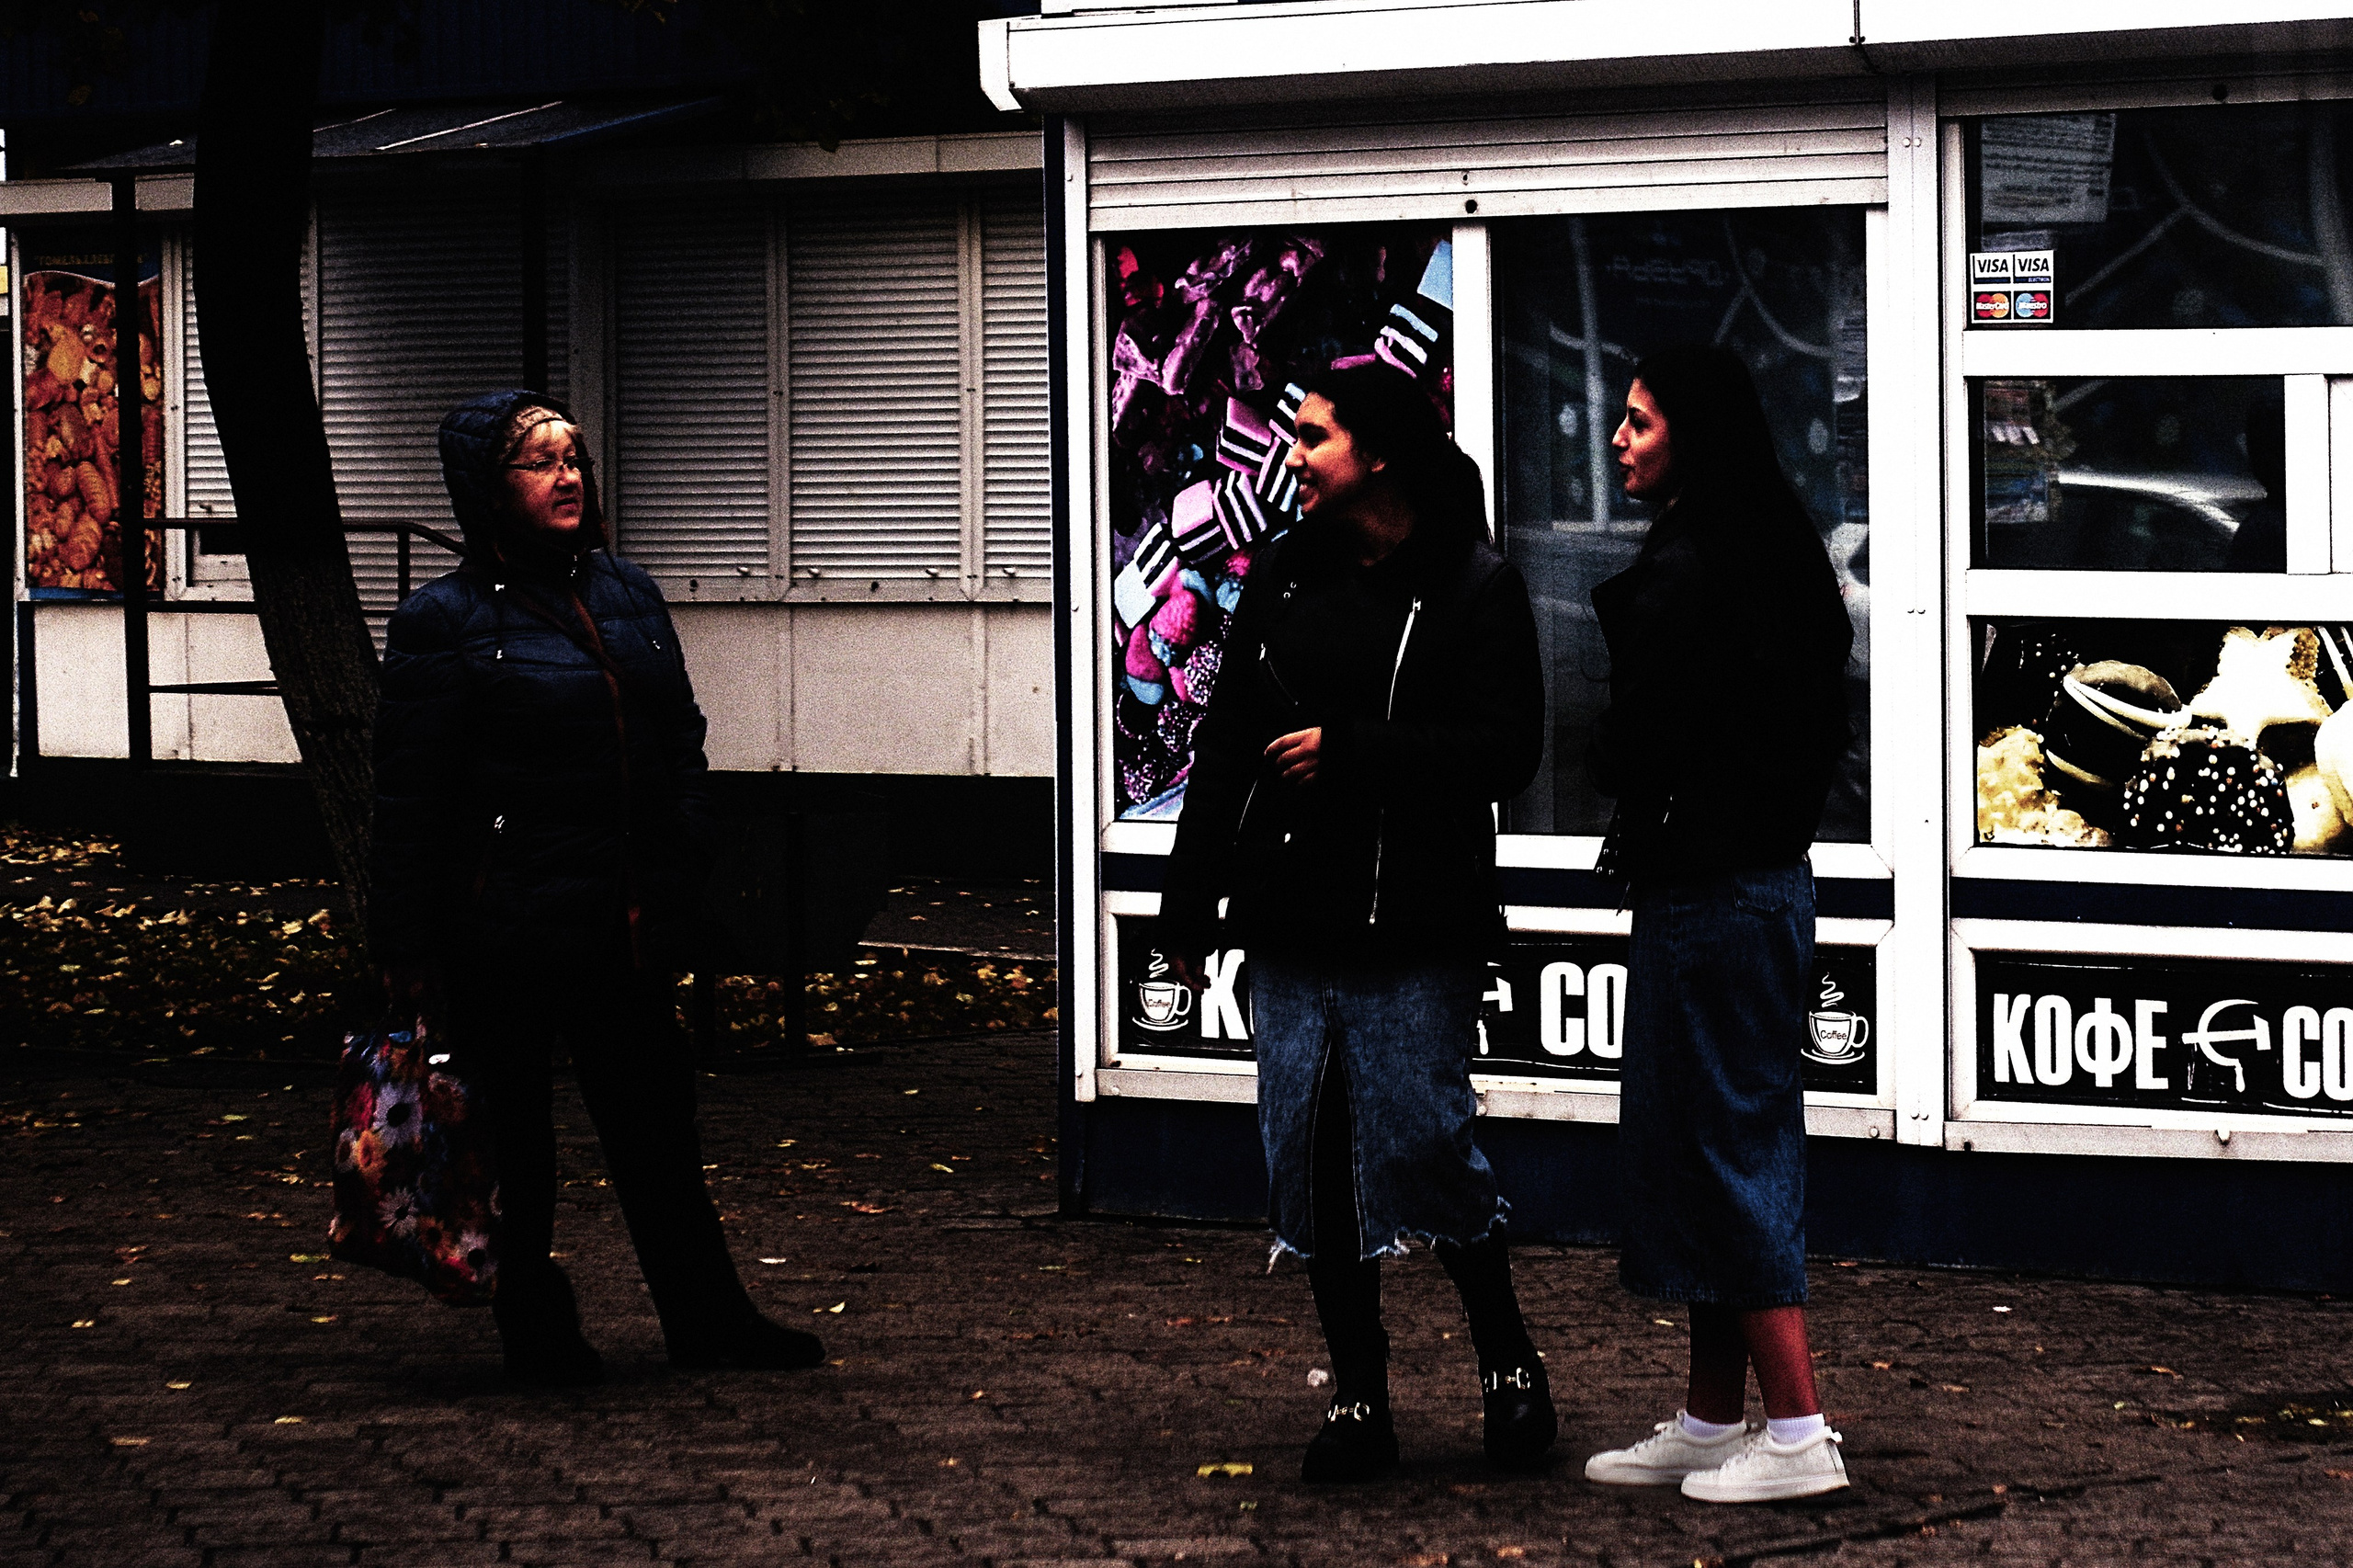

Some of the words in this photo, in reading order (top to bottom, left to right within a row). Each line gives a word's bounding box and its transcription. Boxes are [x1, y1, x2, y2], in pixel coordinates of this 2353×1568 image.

[1977, 258, 2008, 273] VISA
[2018, 258, 2049, 272] VISA
[1820, 1030, 1847, 1040] Coffee
[1993, 993, 2169, 1090] КОФЕ
